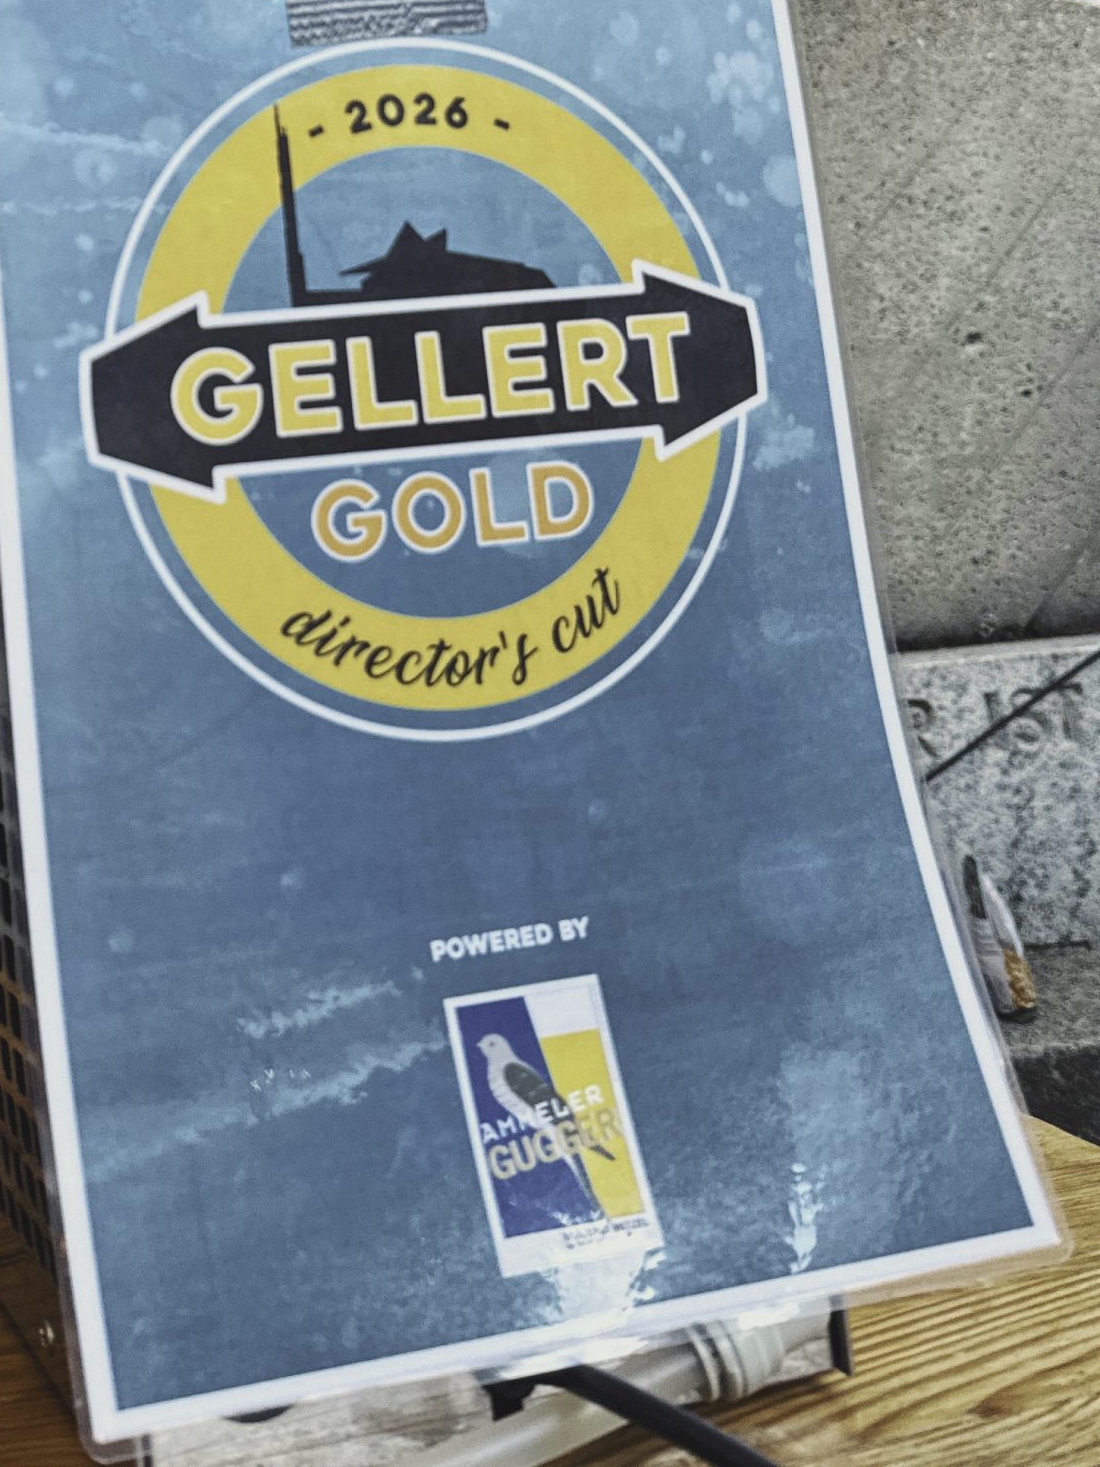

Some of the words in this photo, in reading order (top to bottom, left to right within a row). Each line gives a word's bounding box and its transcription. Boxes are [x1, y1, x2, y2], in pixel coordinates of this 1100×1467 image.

[345, 92, 469, 134] 2026
[170, 311, 691, 446] GELLERT
[311, 460, 595, 562] GOLD
[280, 609, 539, 687] director's
[551, 565, 621, 654] cut
[429, 922, 553, 963] POWERED
[559, 915, 591, 940] BY
[488, 1107, 625, 1181] GUGGER
